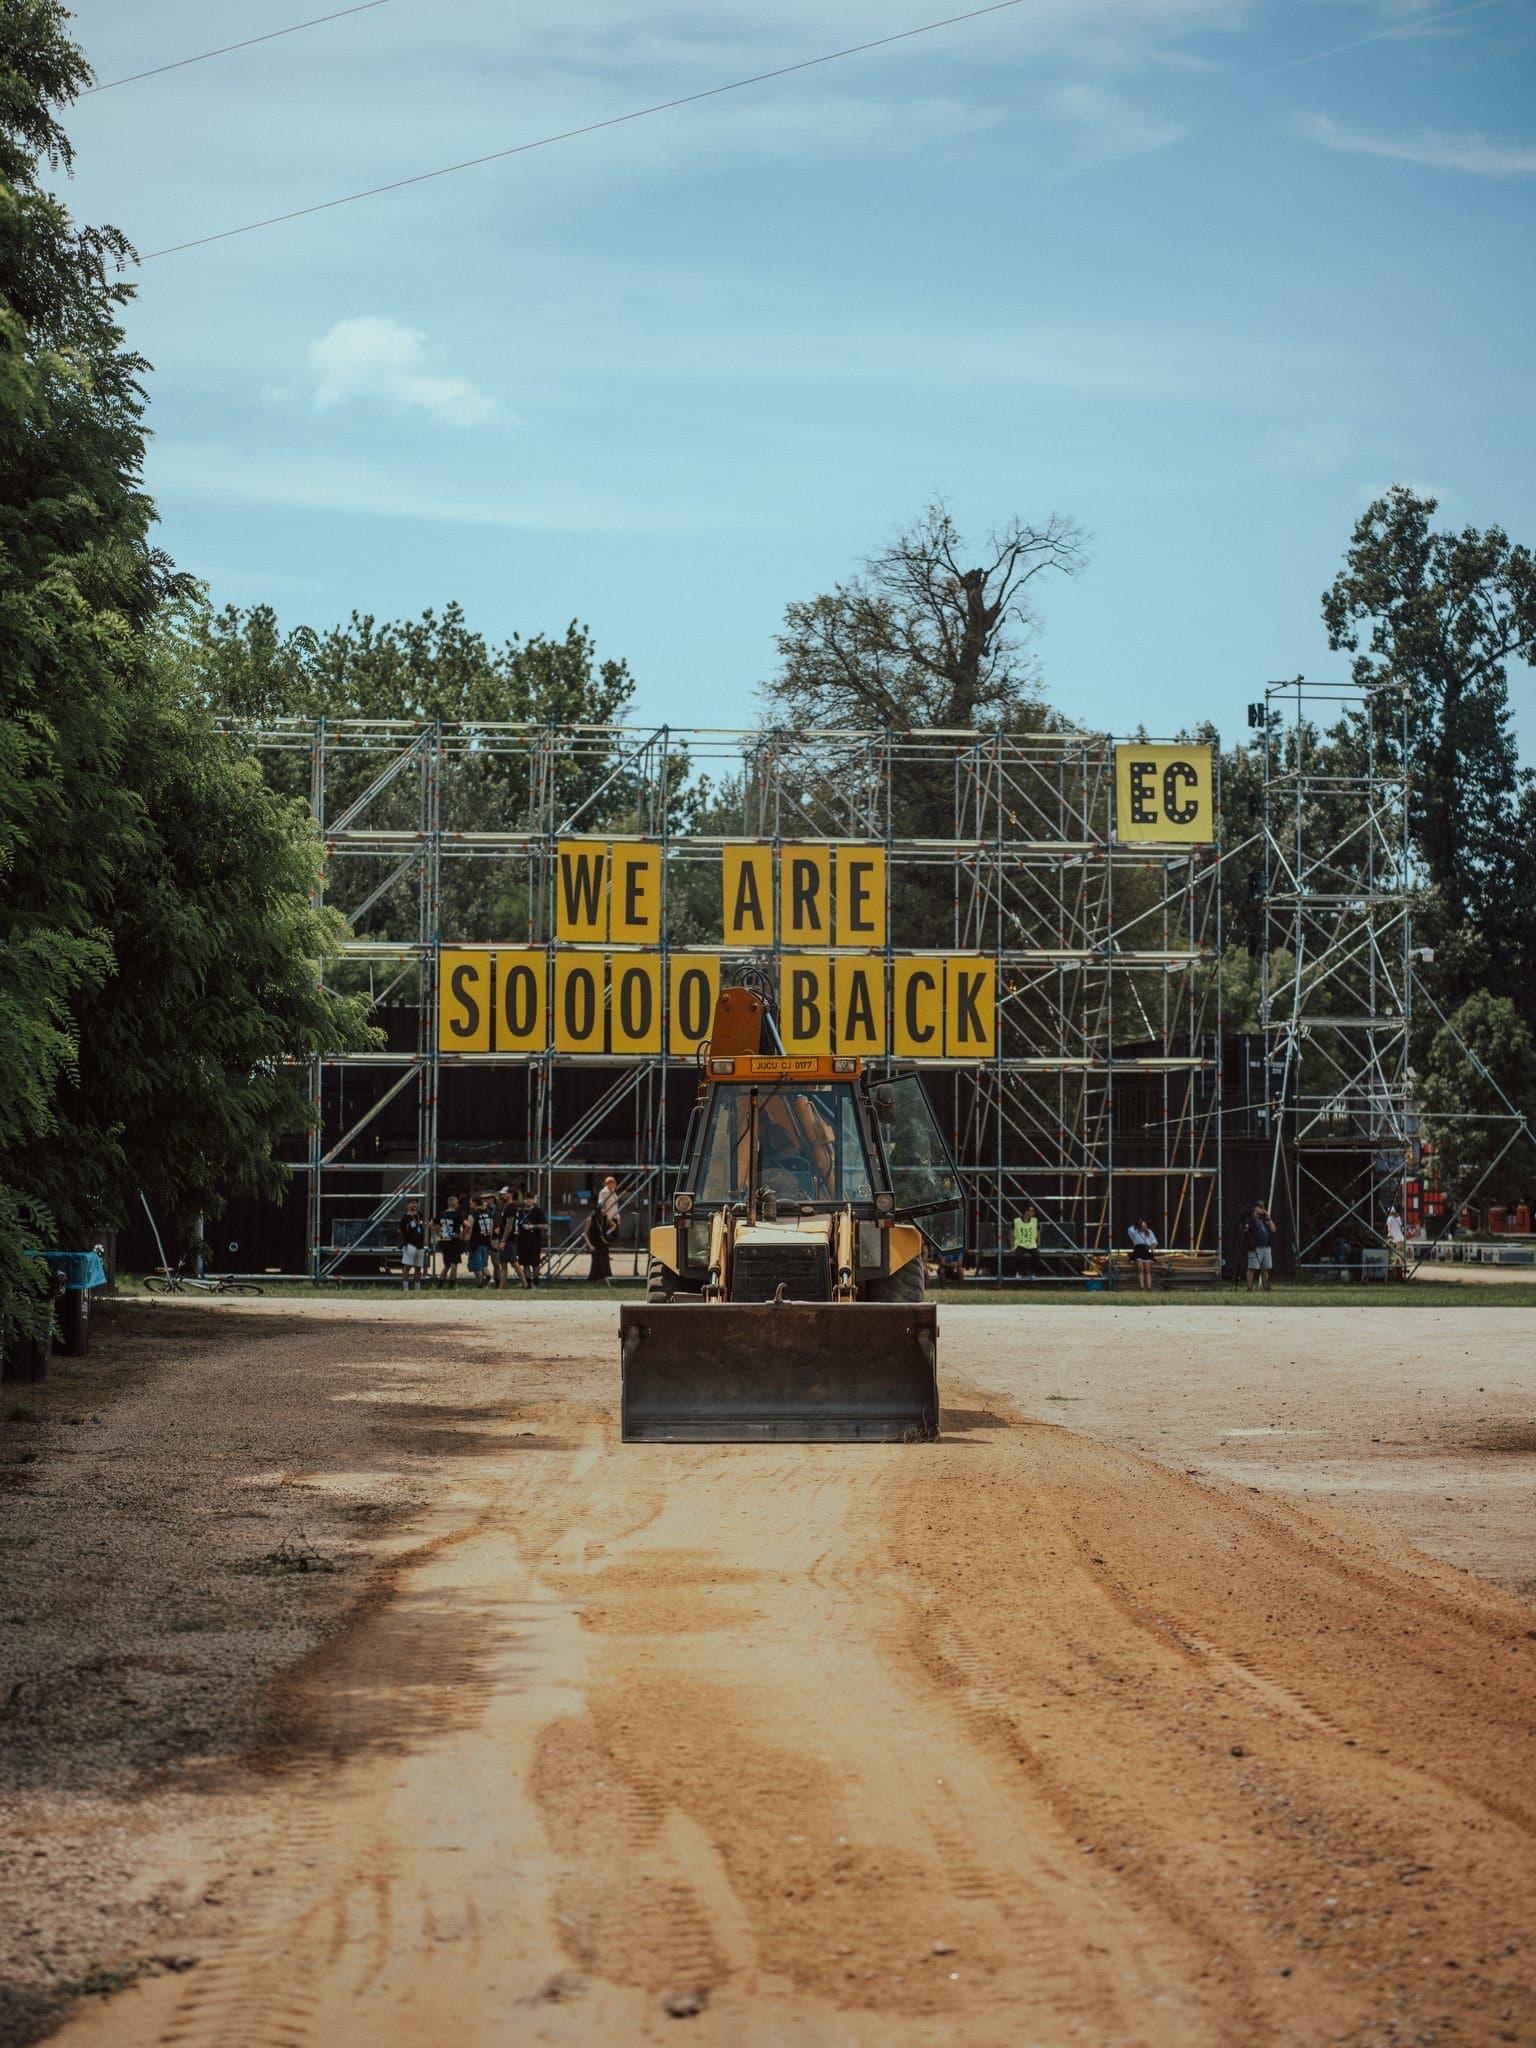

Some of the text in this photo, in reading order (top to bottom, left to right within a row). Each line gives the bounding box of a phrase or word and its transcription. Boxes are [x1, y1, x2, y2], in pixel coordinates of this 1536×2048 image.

[1130, 762, 1198, 824] EC
[561, 854, 875, 931] WE ARE
[450, 964, 987, 1043] SOOOO BACK
